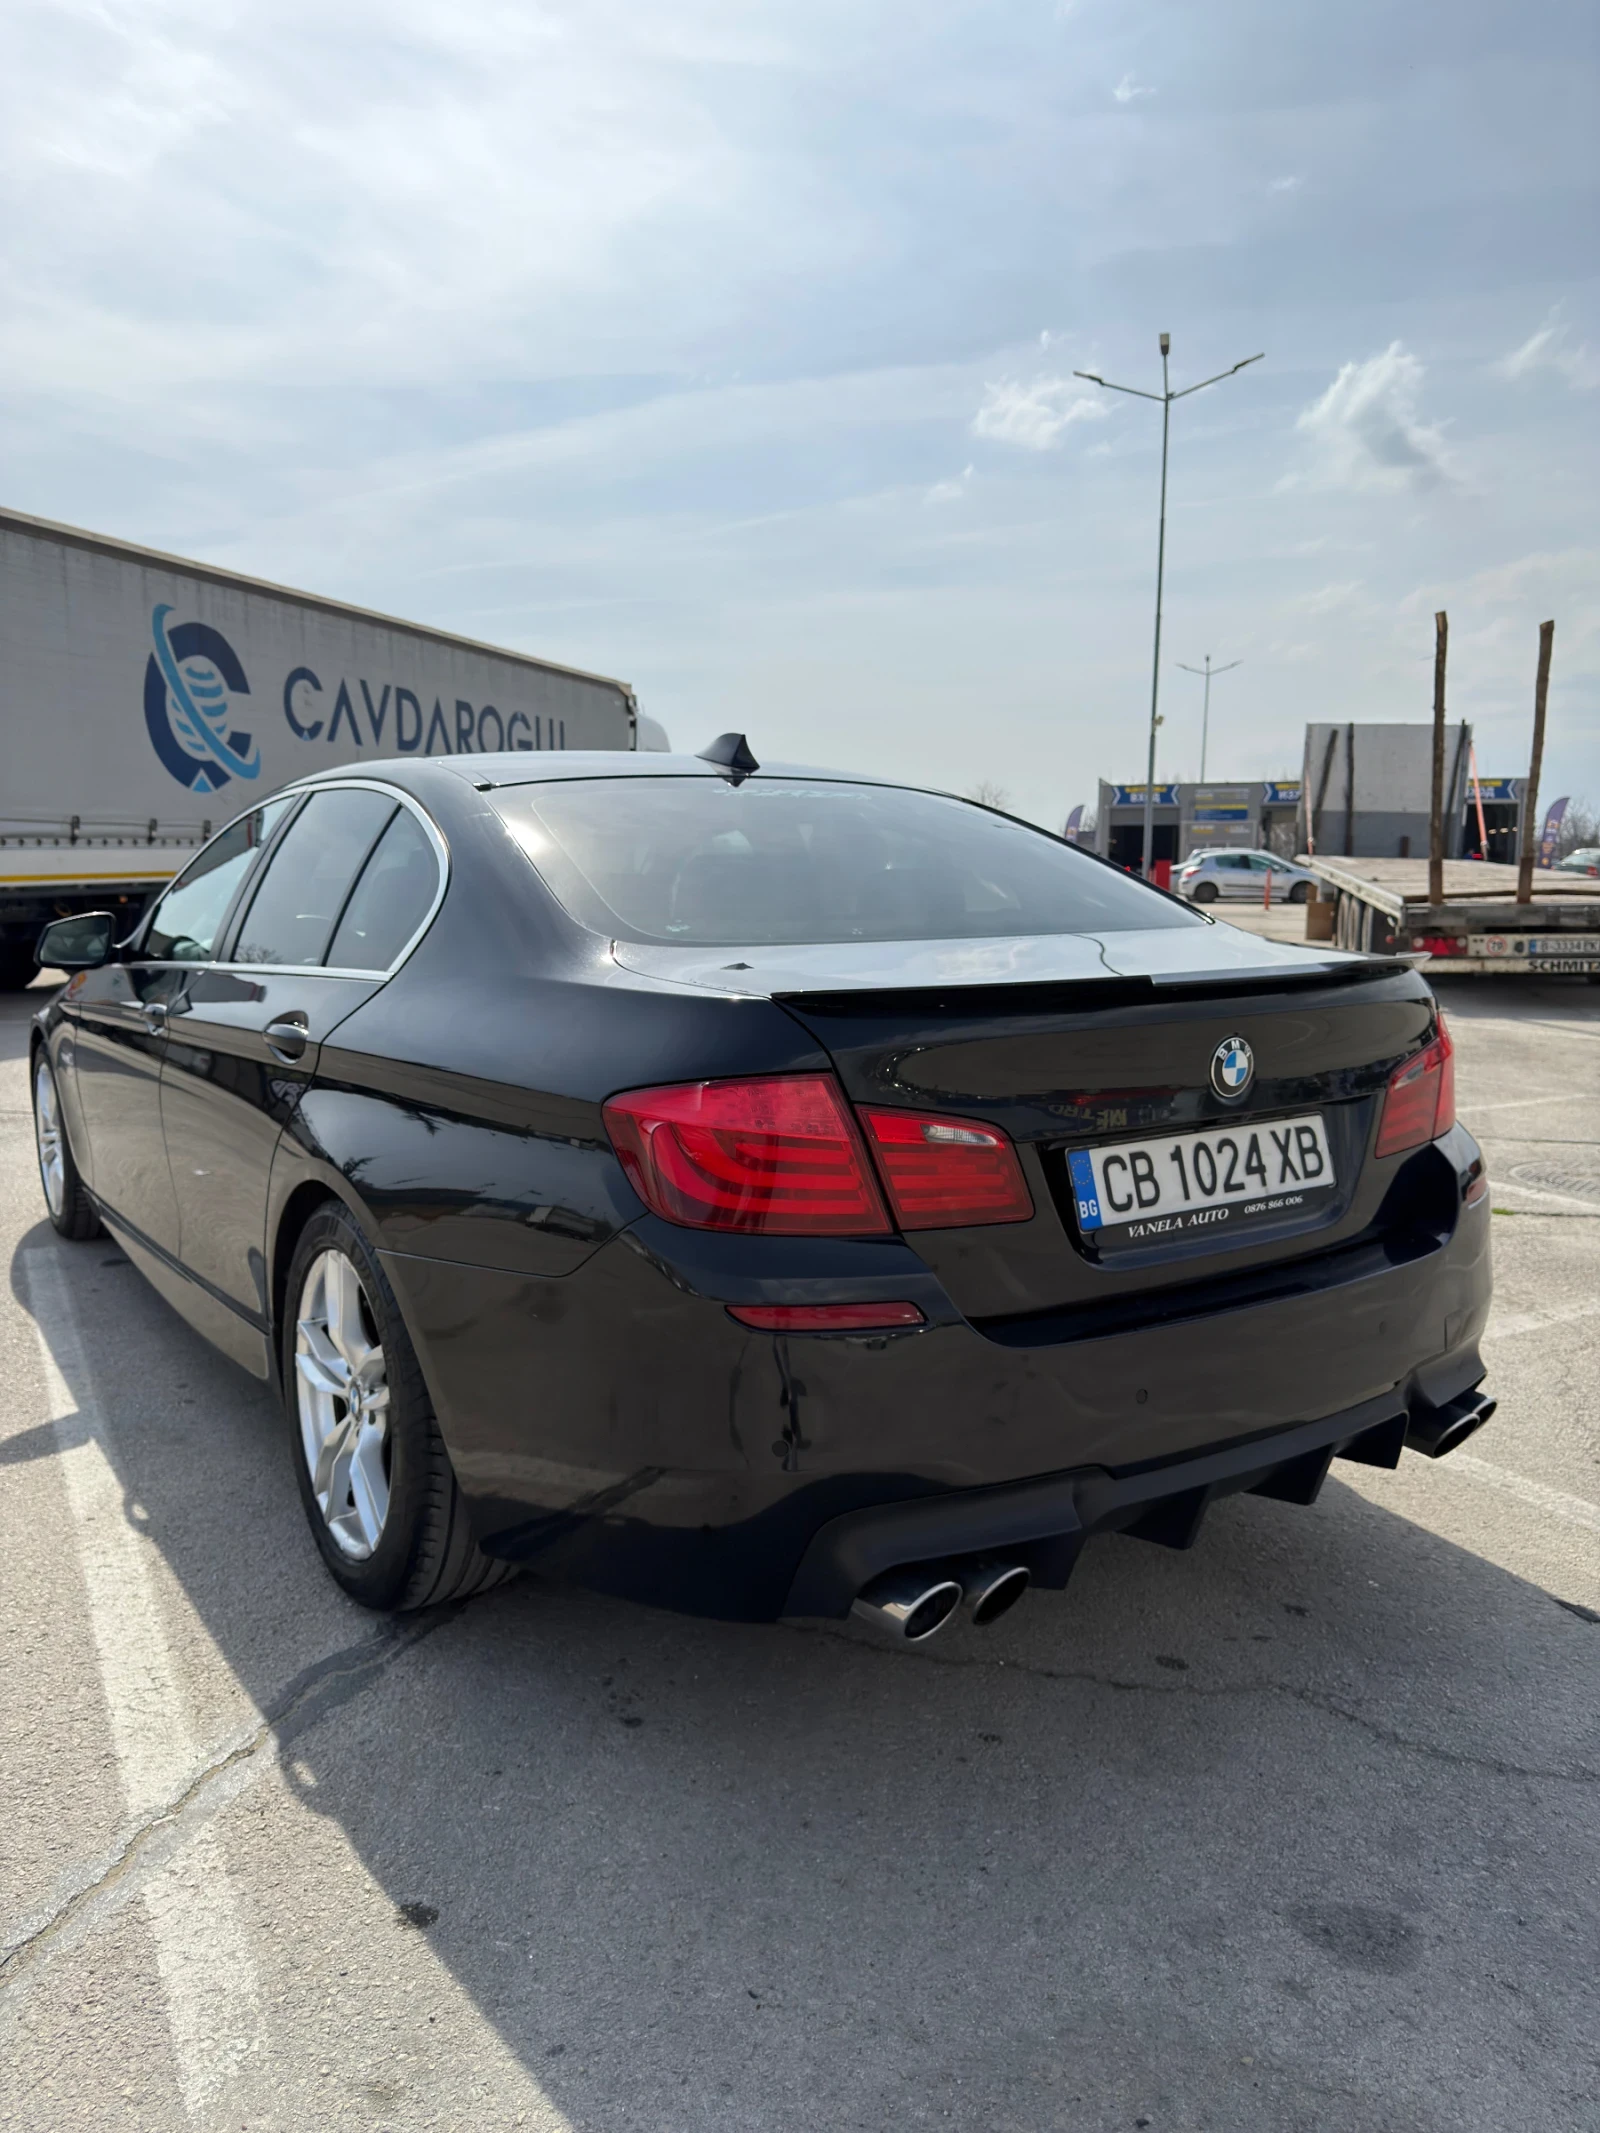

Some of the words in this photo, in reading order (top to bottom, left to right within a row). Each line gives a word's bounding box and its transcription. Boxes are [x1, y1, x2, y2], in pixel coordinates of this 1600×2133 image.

[1218, 1039, 1251, 1060] BMW
[1102, 1151, 1160, 1212] CB
[1170, 1133, 1267, 1200] 1024
[1270, 1126, 1324, 1184] XB
[1079, 1199, 1098, 1218] BG
[1128, 1216, 1183, 1238] VANELA
[1188, 1208, 1229, 1226] AUTO
[1244, 1202, 1266, 1214] 0876
[1268, 1198, 1283, 1209] 866
[1285, 1195, 1303, 1206] 006
